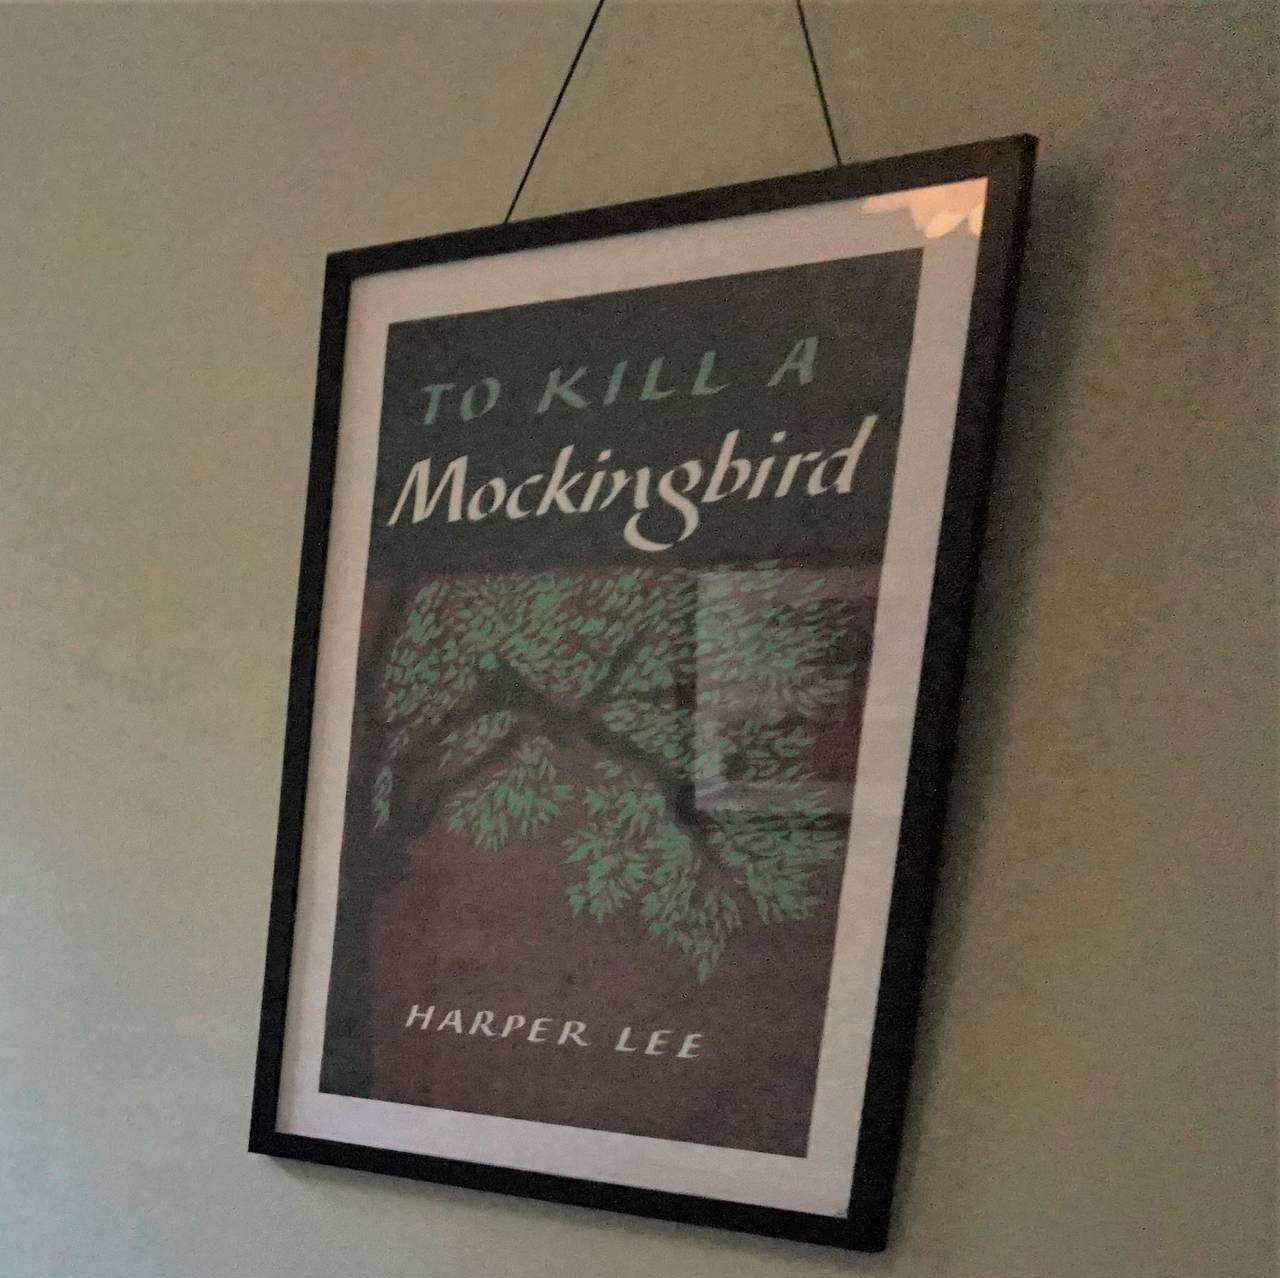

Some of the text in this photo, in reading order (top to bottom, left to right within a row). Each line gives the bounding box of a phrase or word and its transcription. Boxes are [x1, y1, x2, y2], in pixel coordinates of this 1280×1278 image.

[421, 336, 819, 425] TO KILL A
[387, 414, 879, 551] Mockingbird
[405, 1004, 703, 1058] HARPER LEE
